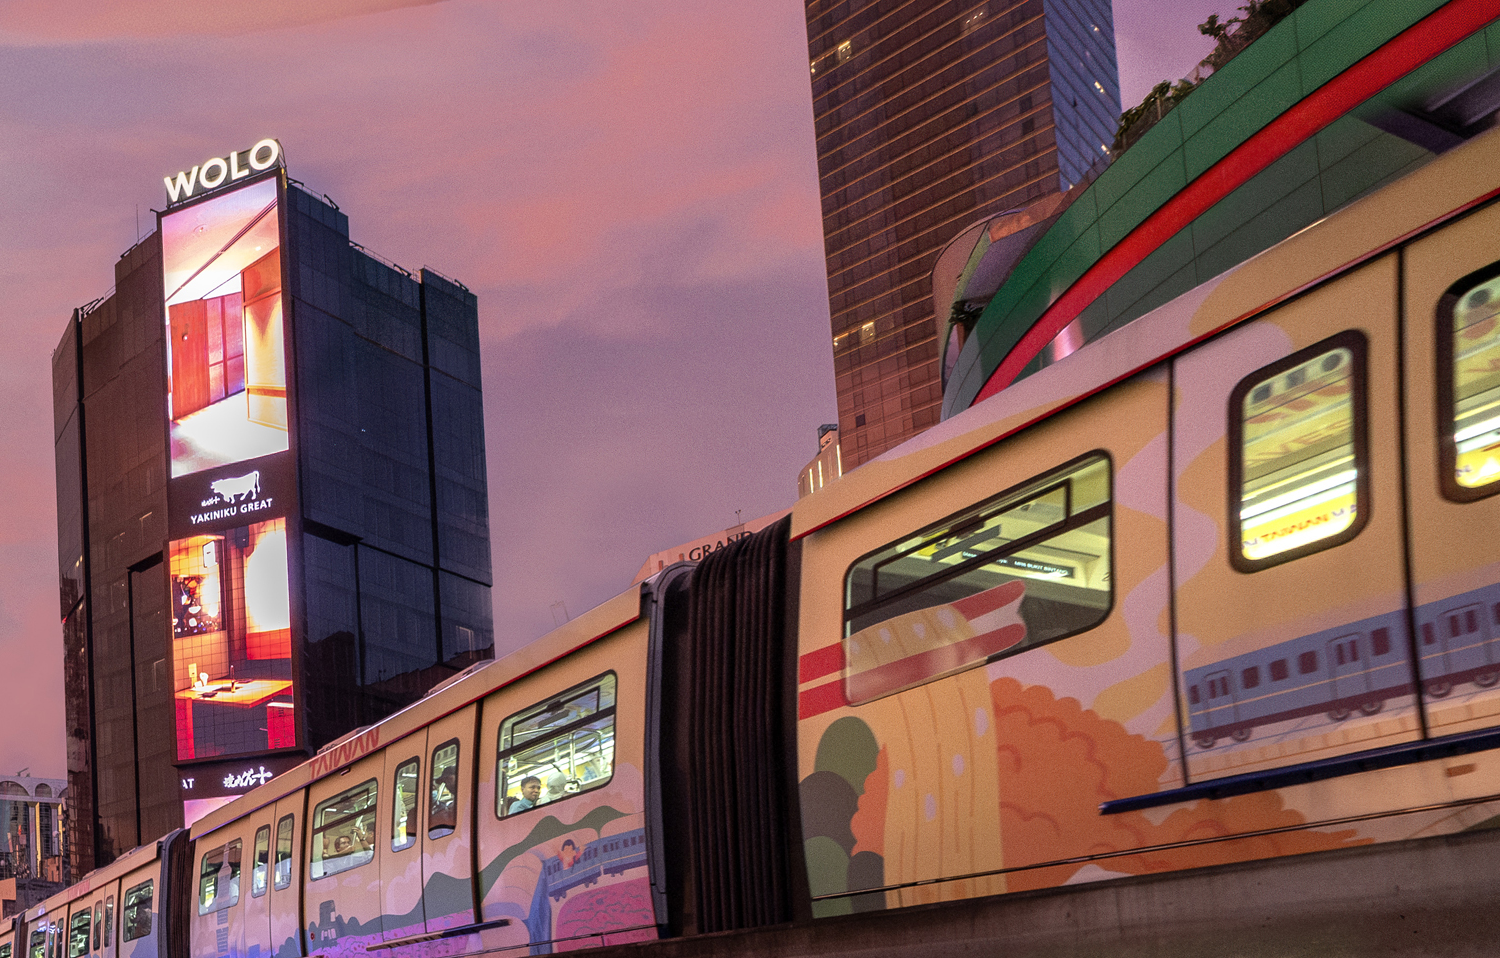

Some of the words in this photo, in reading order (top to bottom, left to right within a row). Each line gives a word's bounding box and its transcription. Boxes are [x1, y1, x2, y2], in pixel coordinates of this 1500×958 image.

[163, 138, 280, 203] WOLO
[190, 506, 237, 524] YAKINIKU
[240, 498, 273, 513] GREAT
[308, 727, 380, 780] TAIWAN
